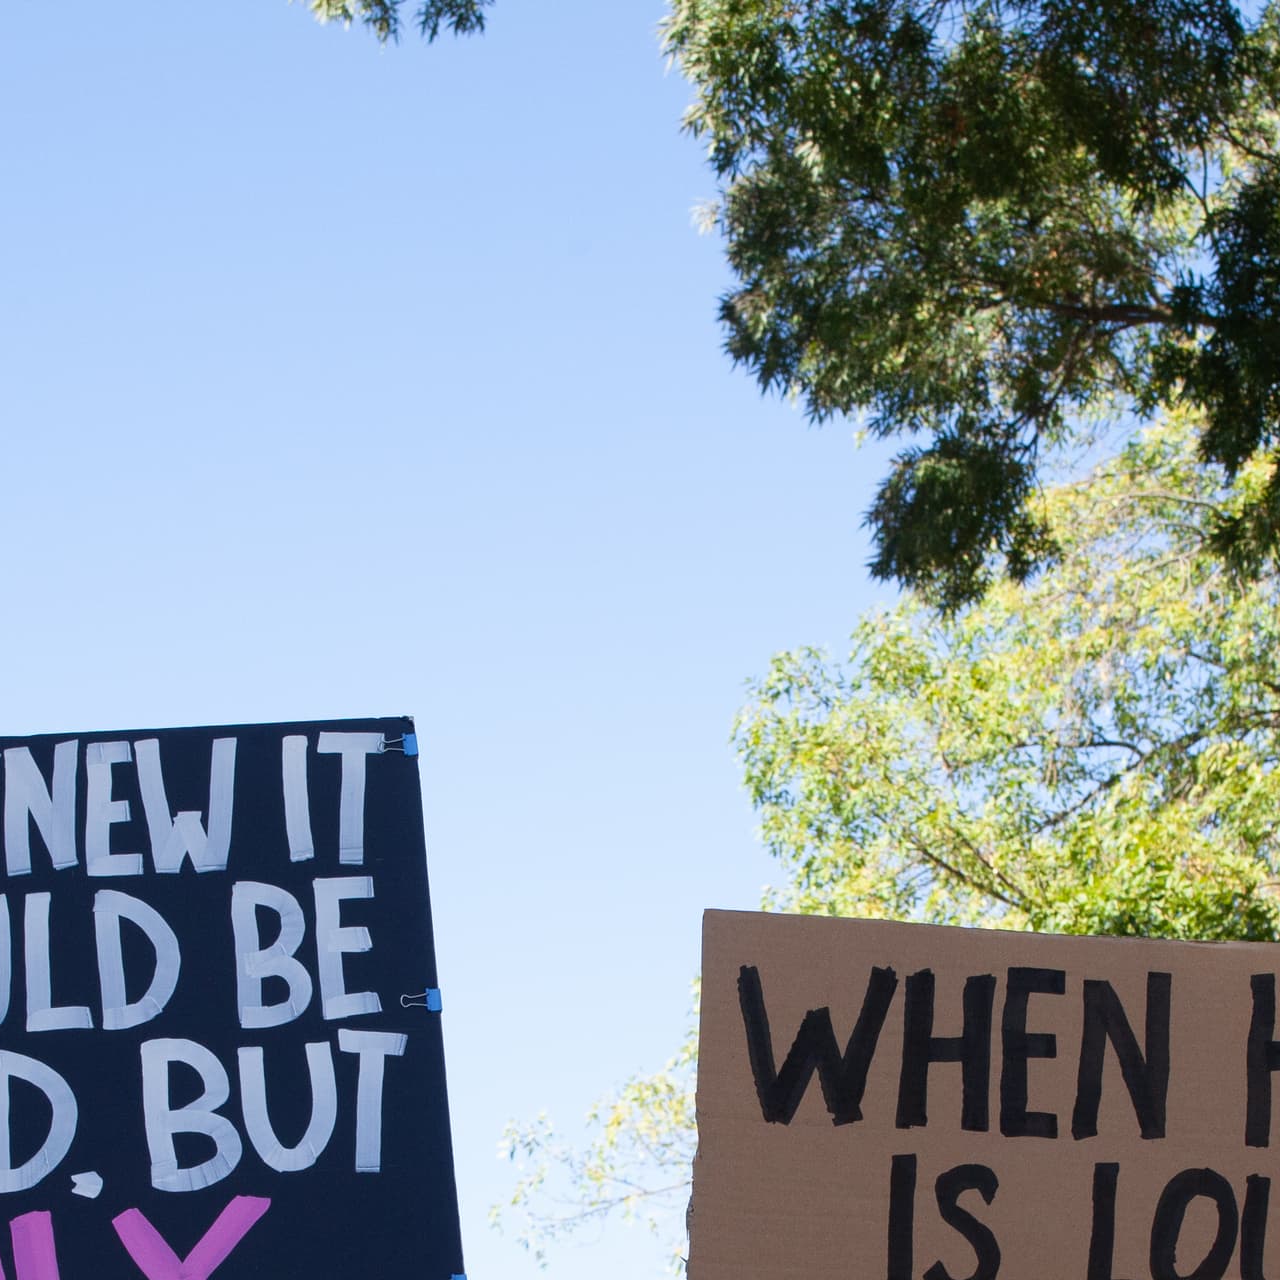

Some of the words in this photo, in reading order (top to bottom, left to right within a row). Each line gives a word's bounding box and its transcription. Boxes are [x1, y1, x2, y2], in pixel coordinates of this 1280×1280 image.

[281, 731, 388, 865] IT
[231, 876, 382, 1029] BE
[139, 1029, 407, 1193] BUT
[736, 963, 1173, 1140] WHEN
